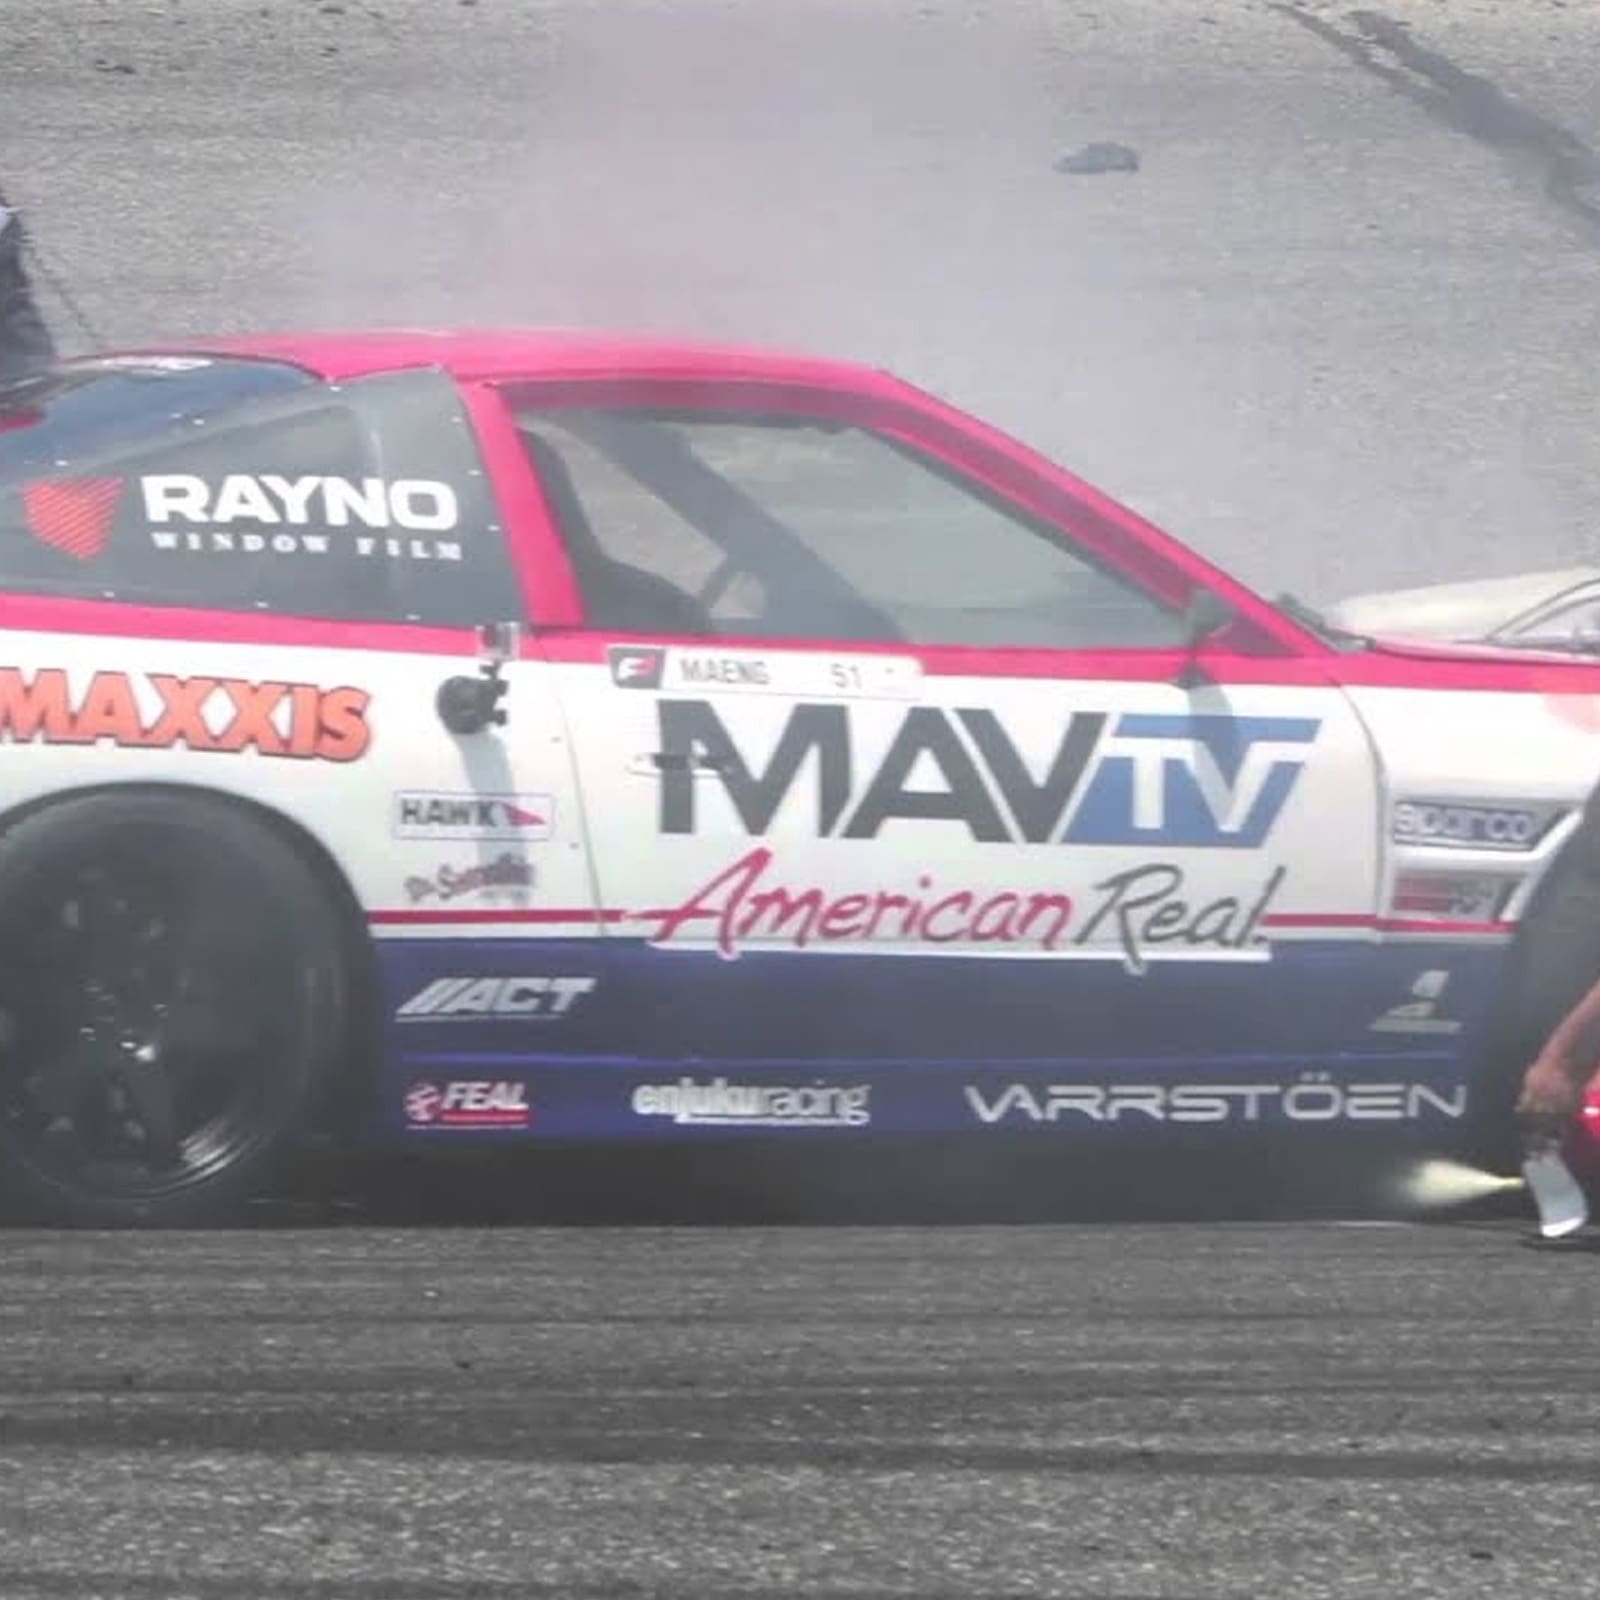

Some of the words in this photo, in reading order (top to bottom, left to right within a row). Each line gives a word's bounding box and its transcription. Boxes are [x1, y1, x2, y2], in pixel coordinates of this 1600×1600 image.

[141, 475, 458, 529] RAYNO
[151, 531, 329, 554] WINDOW
[356, 538, 463, 561] FILM
[679, 658, 770, 685] MAENG
[829, 662, 862, 689] 51
[0, 666, 372, 763] MAXXIS
[656, 699, 1321, 848] MAVTV
[400, 799, 498, 827] HAWK
[634, 847, 1074, 960] American
[440, 1082, 530, 1110] FEAL
[964, 1072, 1467, 1122] VARRSTÖEN
